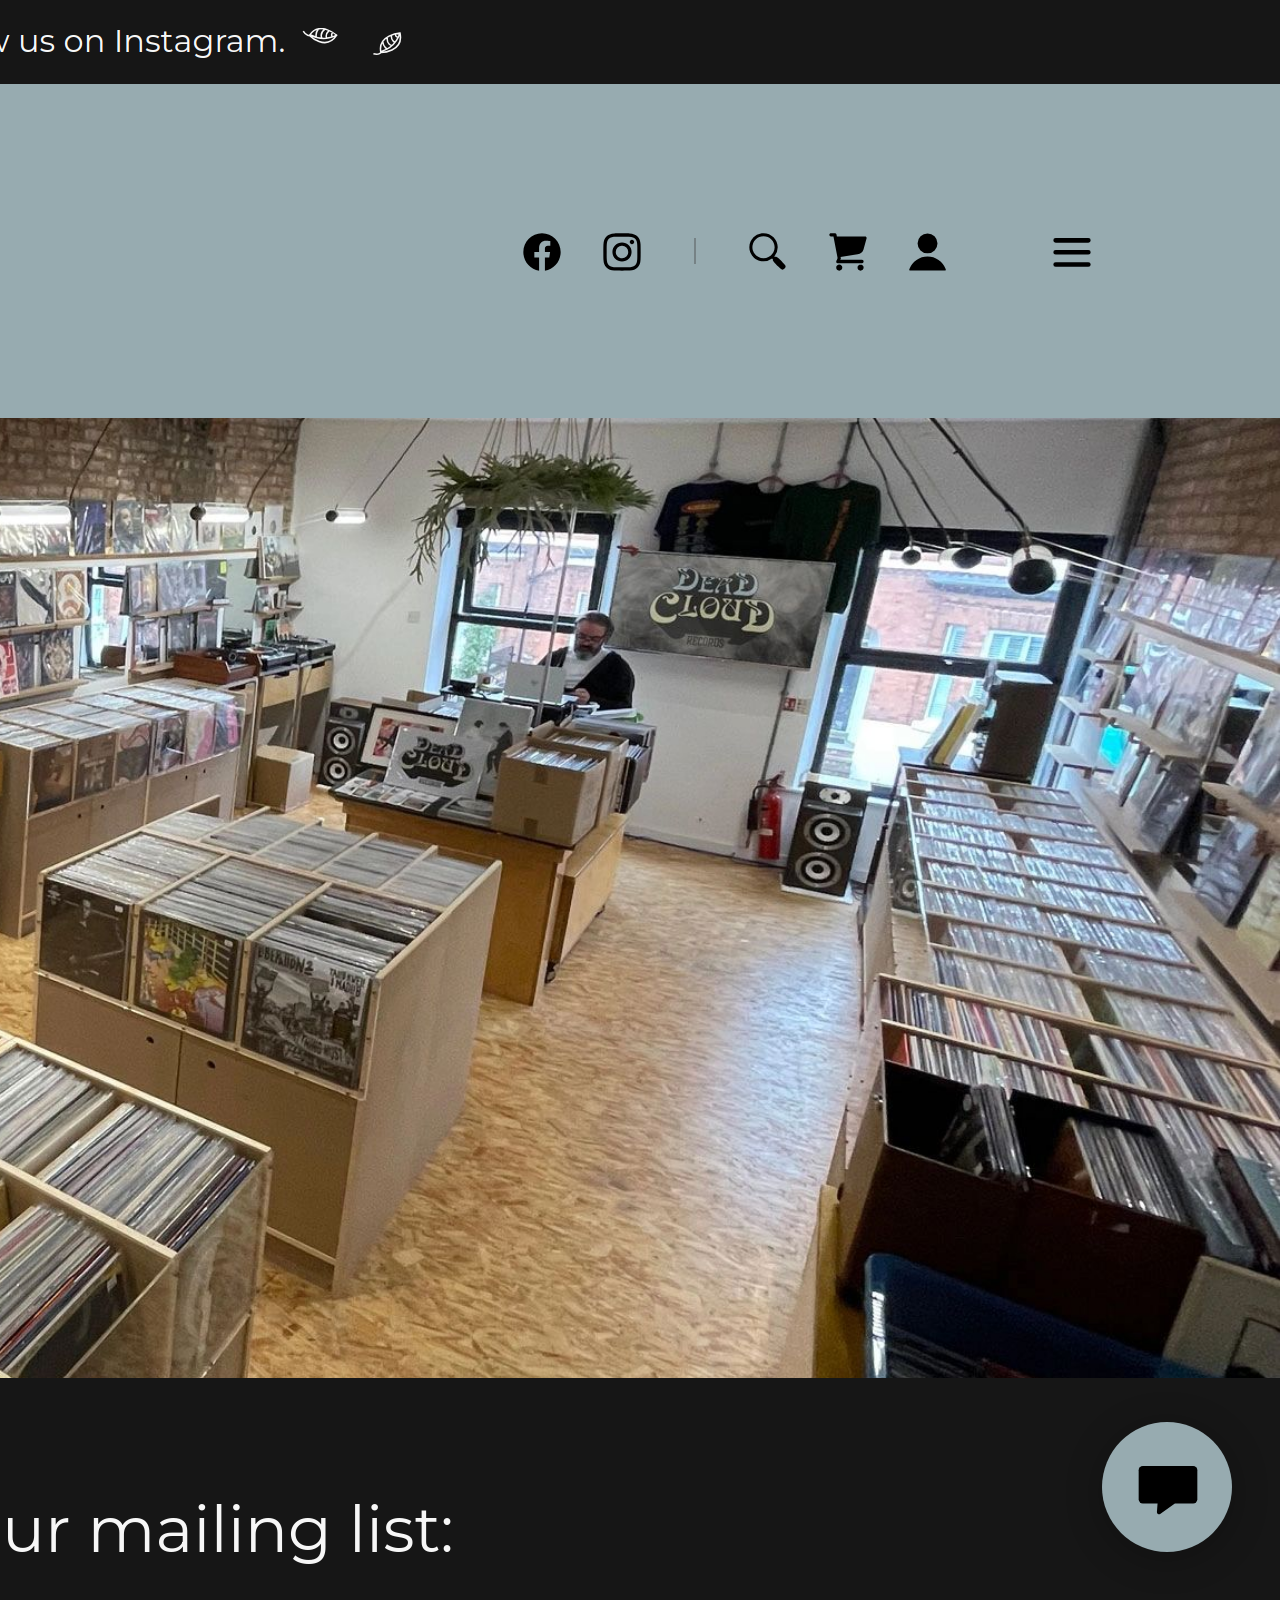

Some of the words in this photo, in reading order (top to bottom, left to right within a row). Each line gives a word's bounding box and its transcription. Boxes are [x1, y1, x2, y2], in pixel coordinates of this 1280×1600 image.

[673, 566, 759, 598] DEAD
[649, 592, 774, 634] CLOUD
[685, 634, 725, 649] RECORDS
